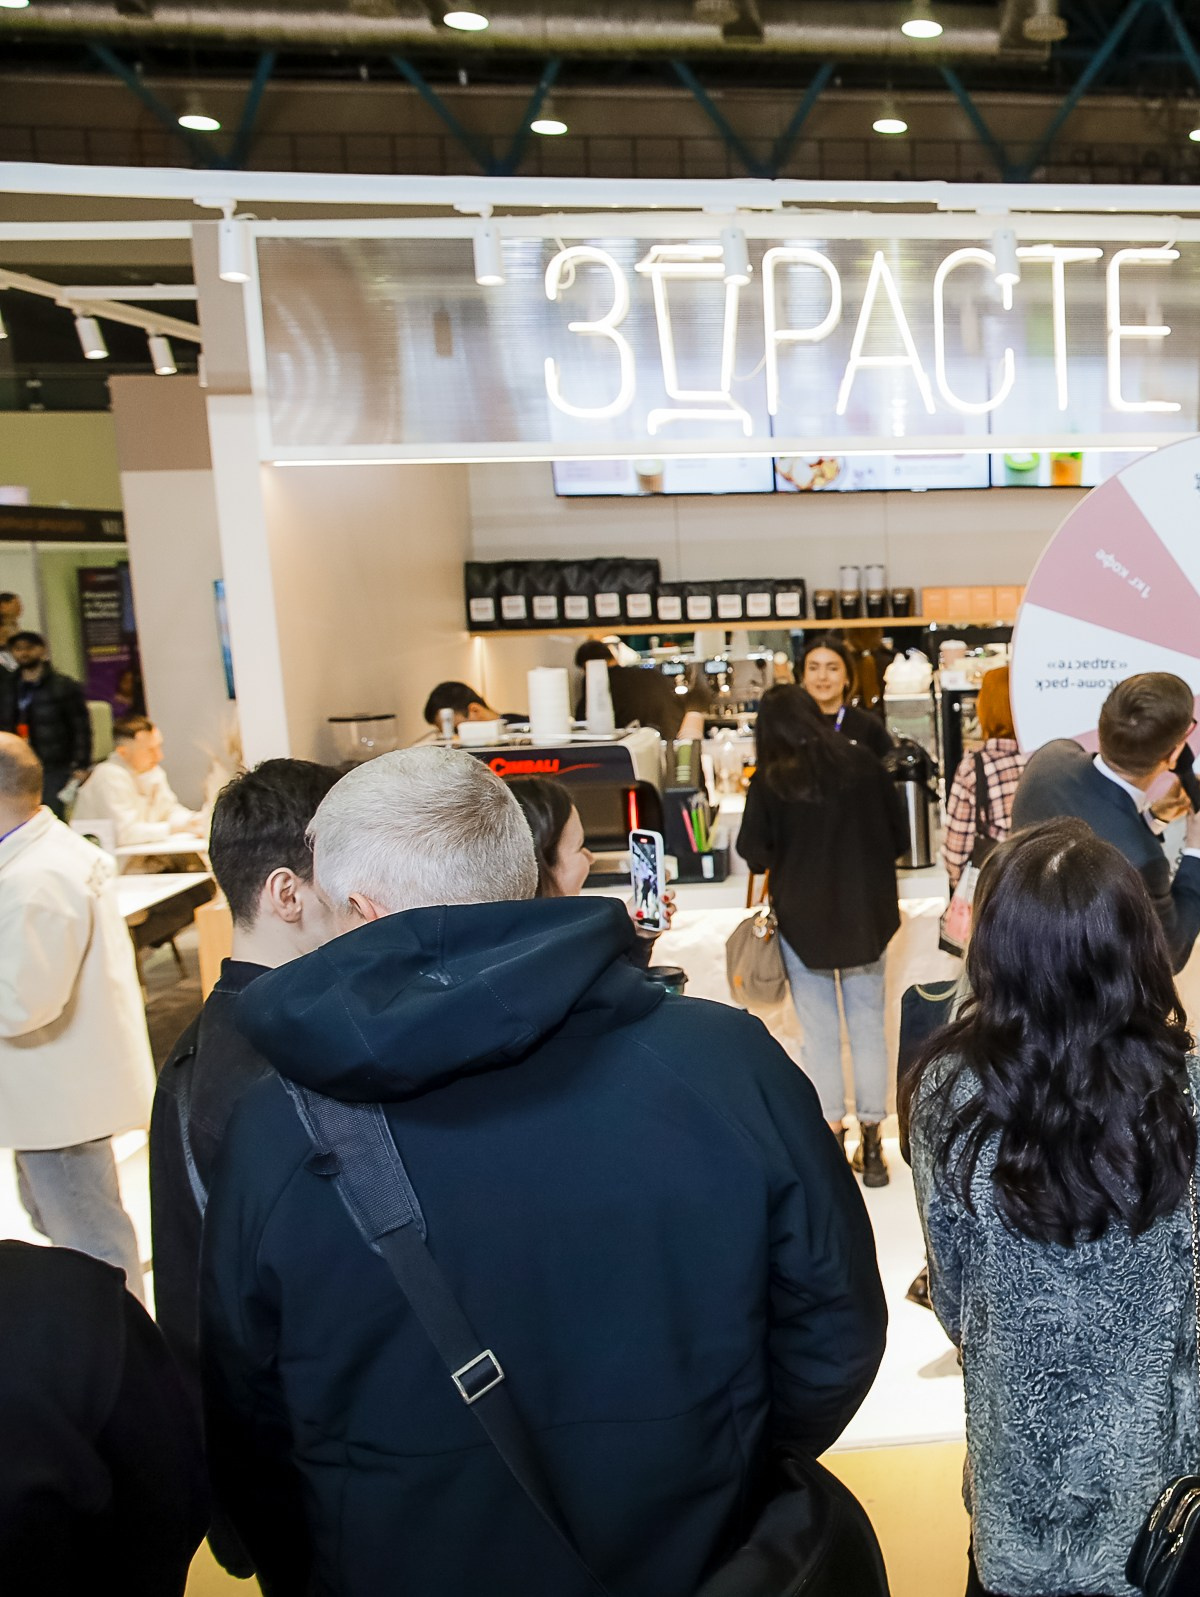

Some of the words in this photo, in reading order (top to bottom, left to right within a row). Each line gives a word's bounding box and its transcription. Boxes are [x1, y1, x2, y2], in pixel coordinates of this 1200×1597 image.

[545, 246, 1182, 435] ЗДРАСТЕ
[1095, 548, 1129, 578] кофе
[1128, 577, 1151, 598] 1кг
[1035, 677, 1119, 691] come-pack
